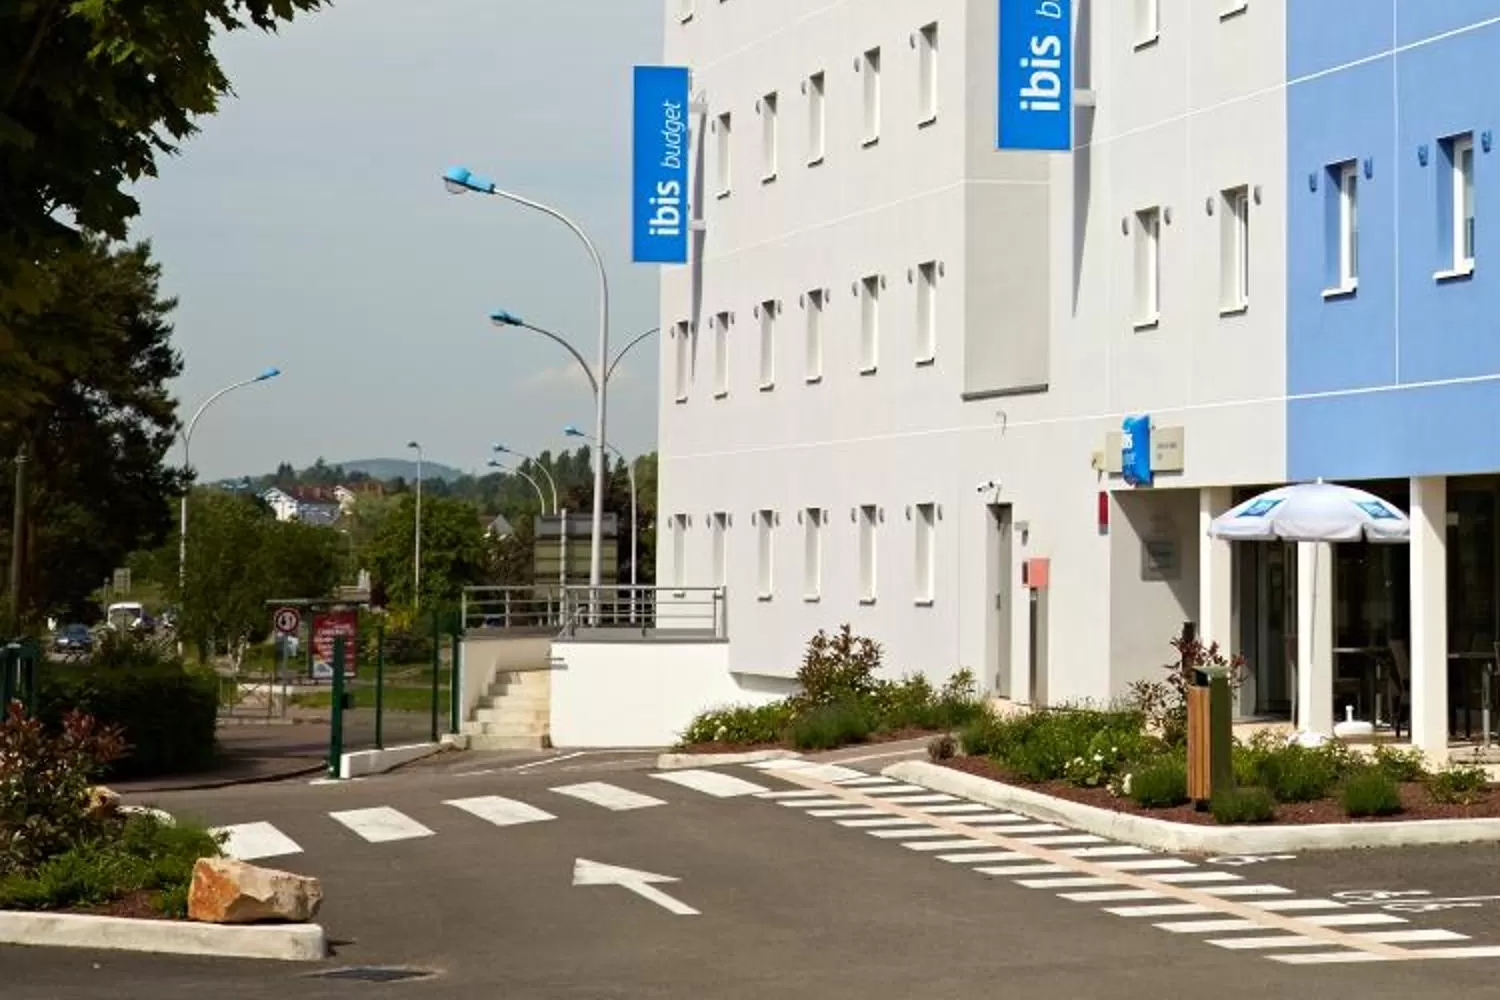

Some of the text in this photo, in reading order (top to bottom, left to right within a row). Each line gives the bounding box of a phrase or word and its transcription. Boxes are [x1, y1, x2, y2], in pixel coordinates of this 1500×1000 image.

[1019, 34, 1061, 111] ibis
[648, 100, 685, 236] ibis budget
